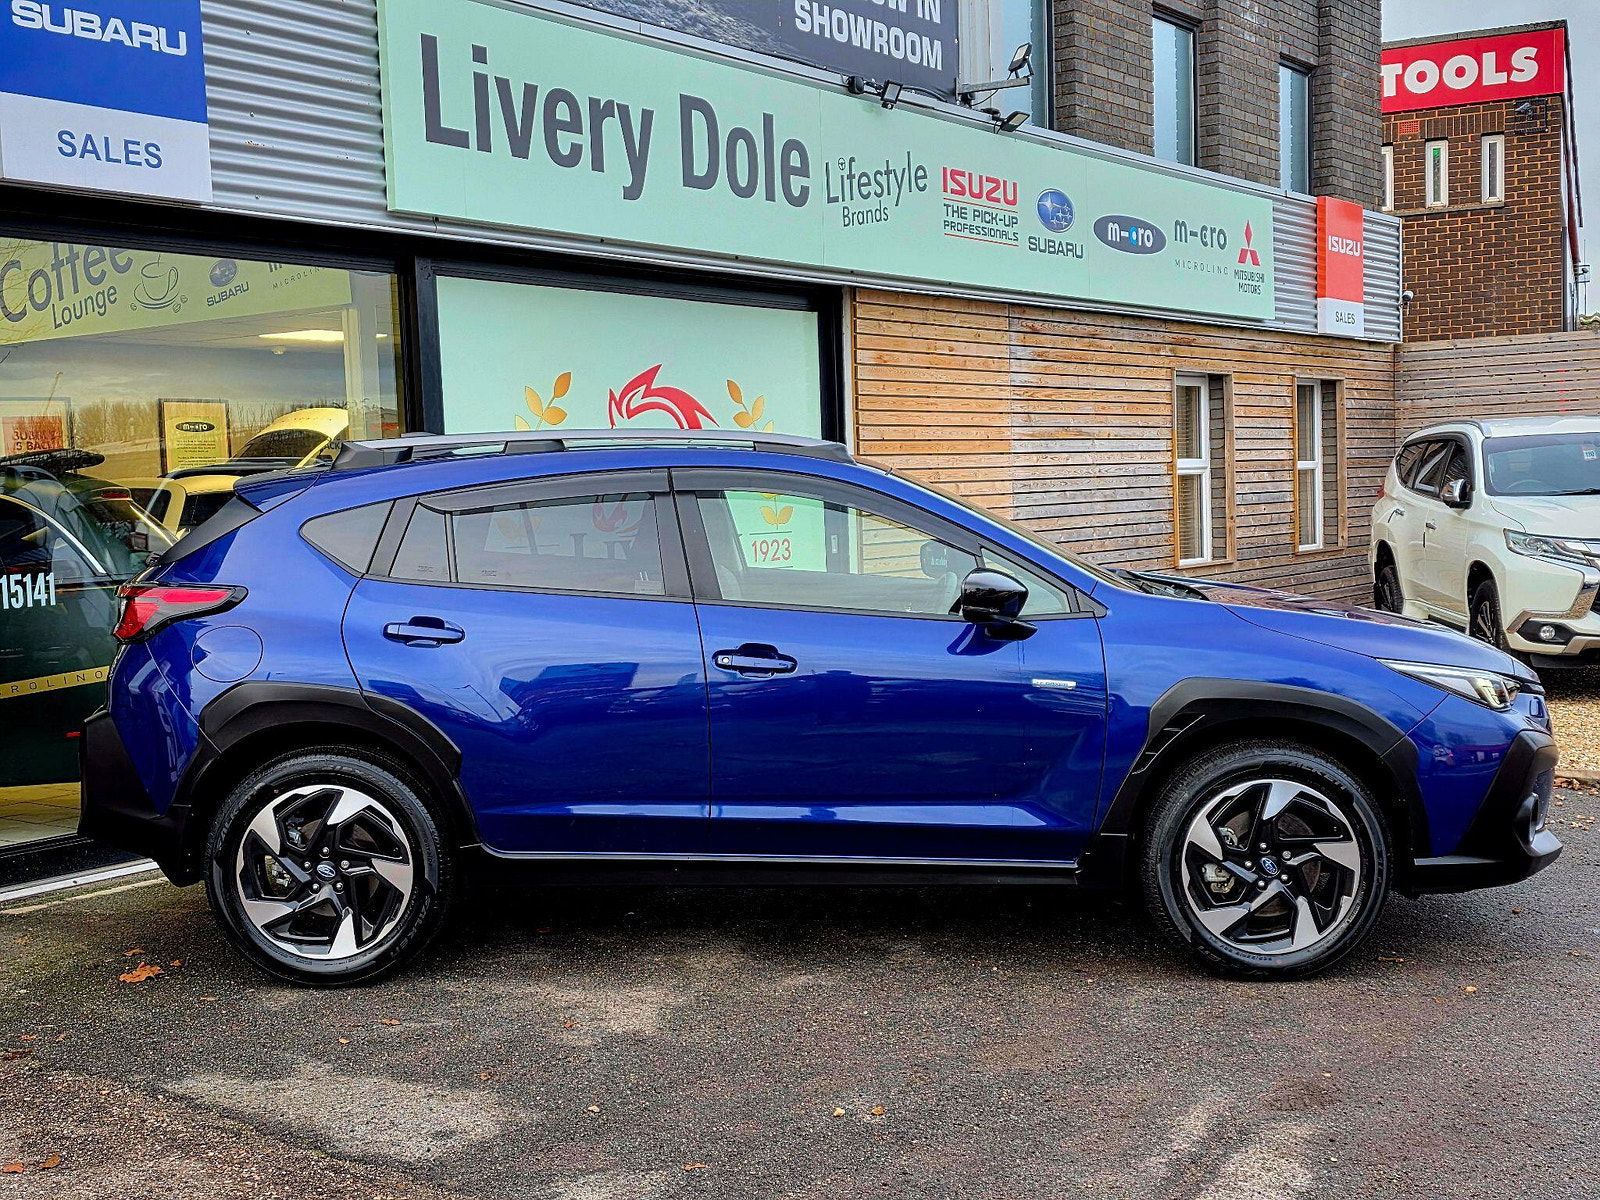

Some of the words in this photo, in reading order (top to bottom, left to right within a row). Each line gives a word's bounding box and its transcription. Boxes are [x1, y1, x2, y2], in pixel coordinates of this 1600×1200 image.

[11, 0, 188, 56] SUBARU
[795, 0, 943, 71] SHOWROOM
[1381, 46, 1539, 97] TOOLS
[420, 33, 654, 200] Livery
[679, 92, 810, 207] Dole
[57, 129, 163, 169] SALES
[825, 151, 928, 206] Lifestyle
[942, 166, 1018, 206] ISUZU
[842, 202, 889, 227] Brands
[944, 203, 968, 221] THE
[973, 209, 1018, 228] PICK-UP
[944, 220, 1019, 242] PROFESSIONALS
[1028, 235, 1084, 259] SUBARU
[1328, 235, 1360, 257] ISUZU
[0, 241, 134, 322] Coffee
[1234, 269, 1265, 283] MITSUBISHI
[1238, 282, 1261, 295] MOTORS
[206, 281, 250, 307] SUBARU
[52, 286, 117, 329] Lounge
[1335, 311, 1356, 325] SALES
[751, 538, 792, 563] 1923
[0, 572, 57, 610] 15141
[0, 670, 103, 695] ROLINO
